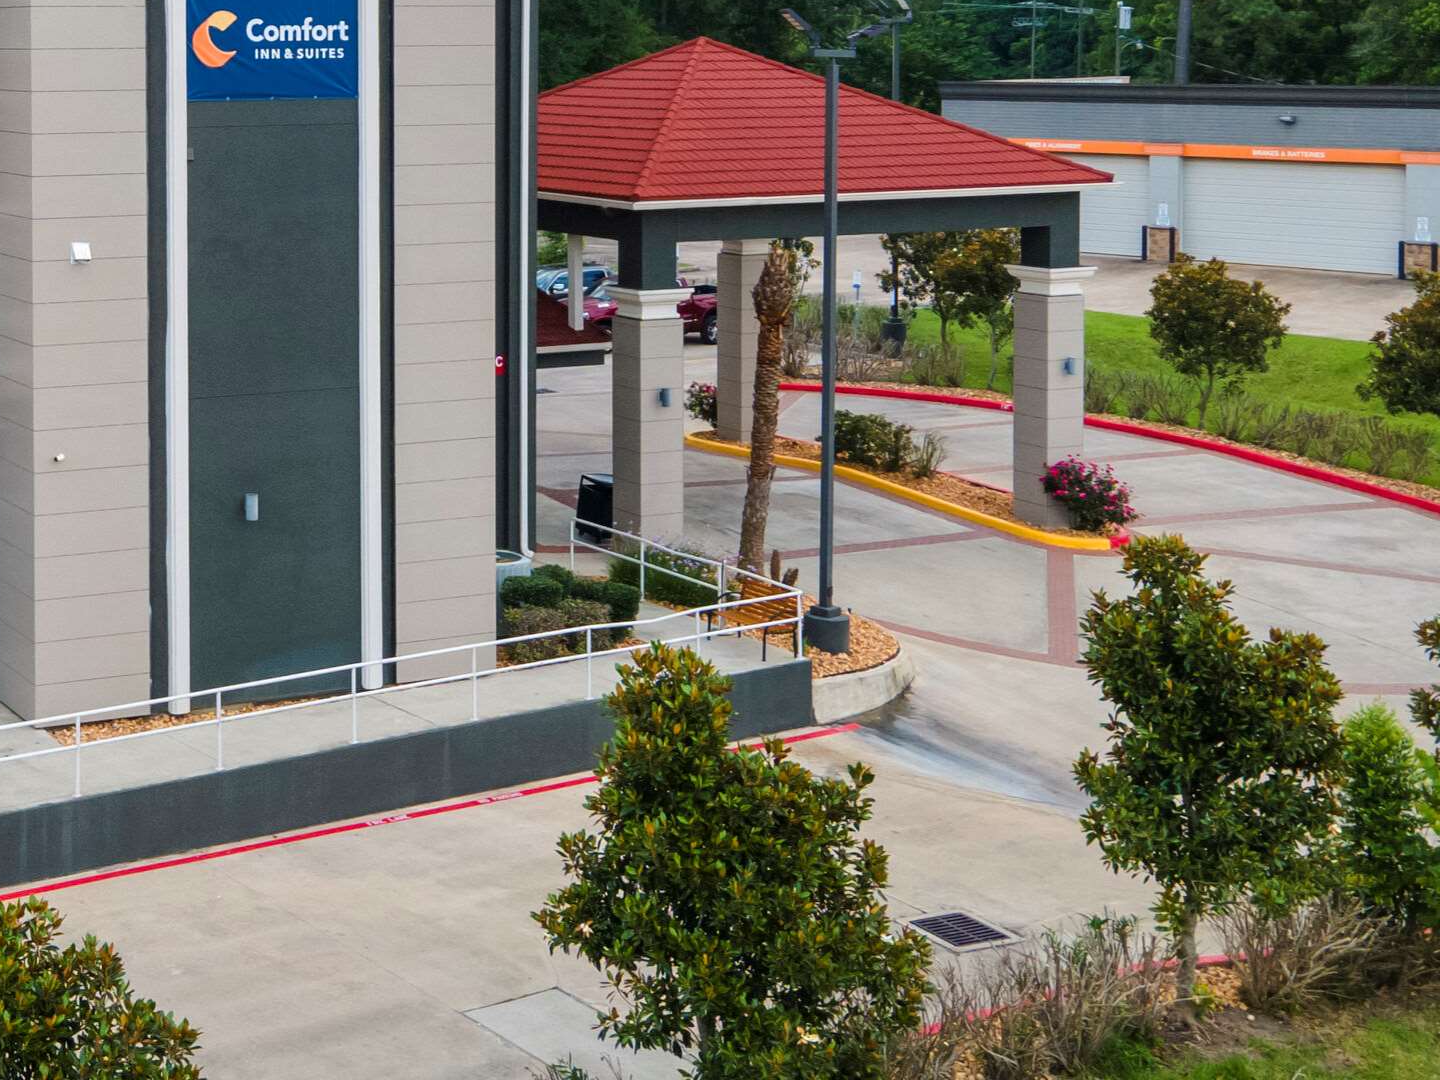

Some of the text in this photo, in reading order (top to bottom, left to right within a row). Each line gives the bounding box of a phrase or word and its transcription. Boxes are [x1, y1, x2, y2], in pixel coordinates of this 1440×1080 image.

[246, 17, 349, 42] Comfort
[255, 48, 345, 60] INN & SUITES
